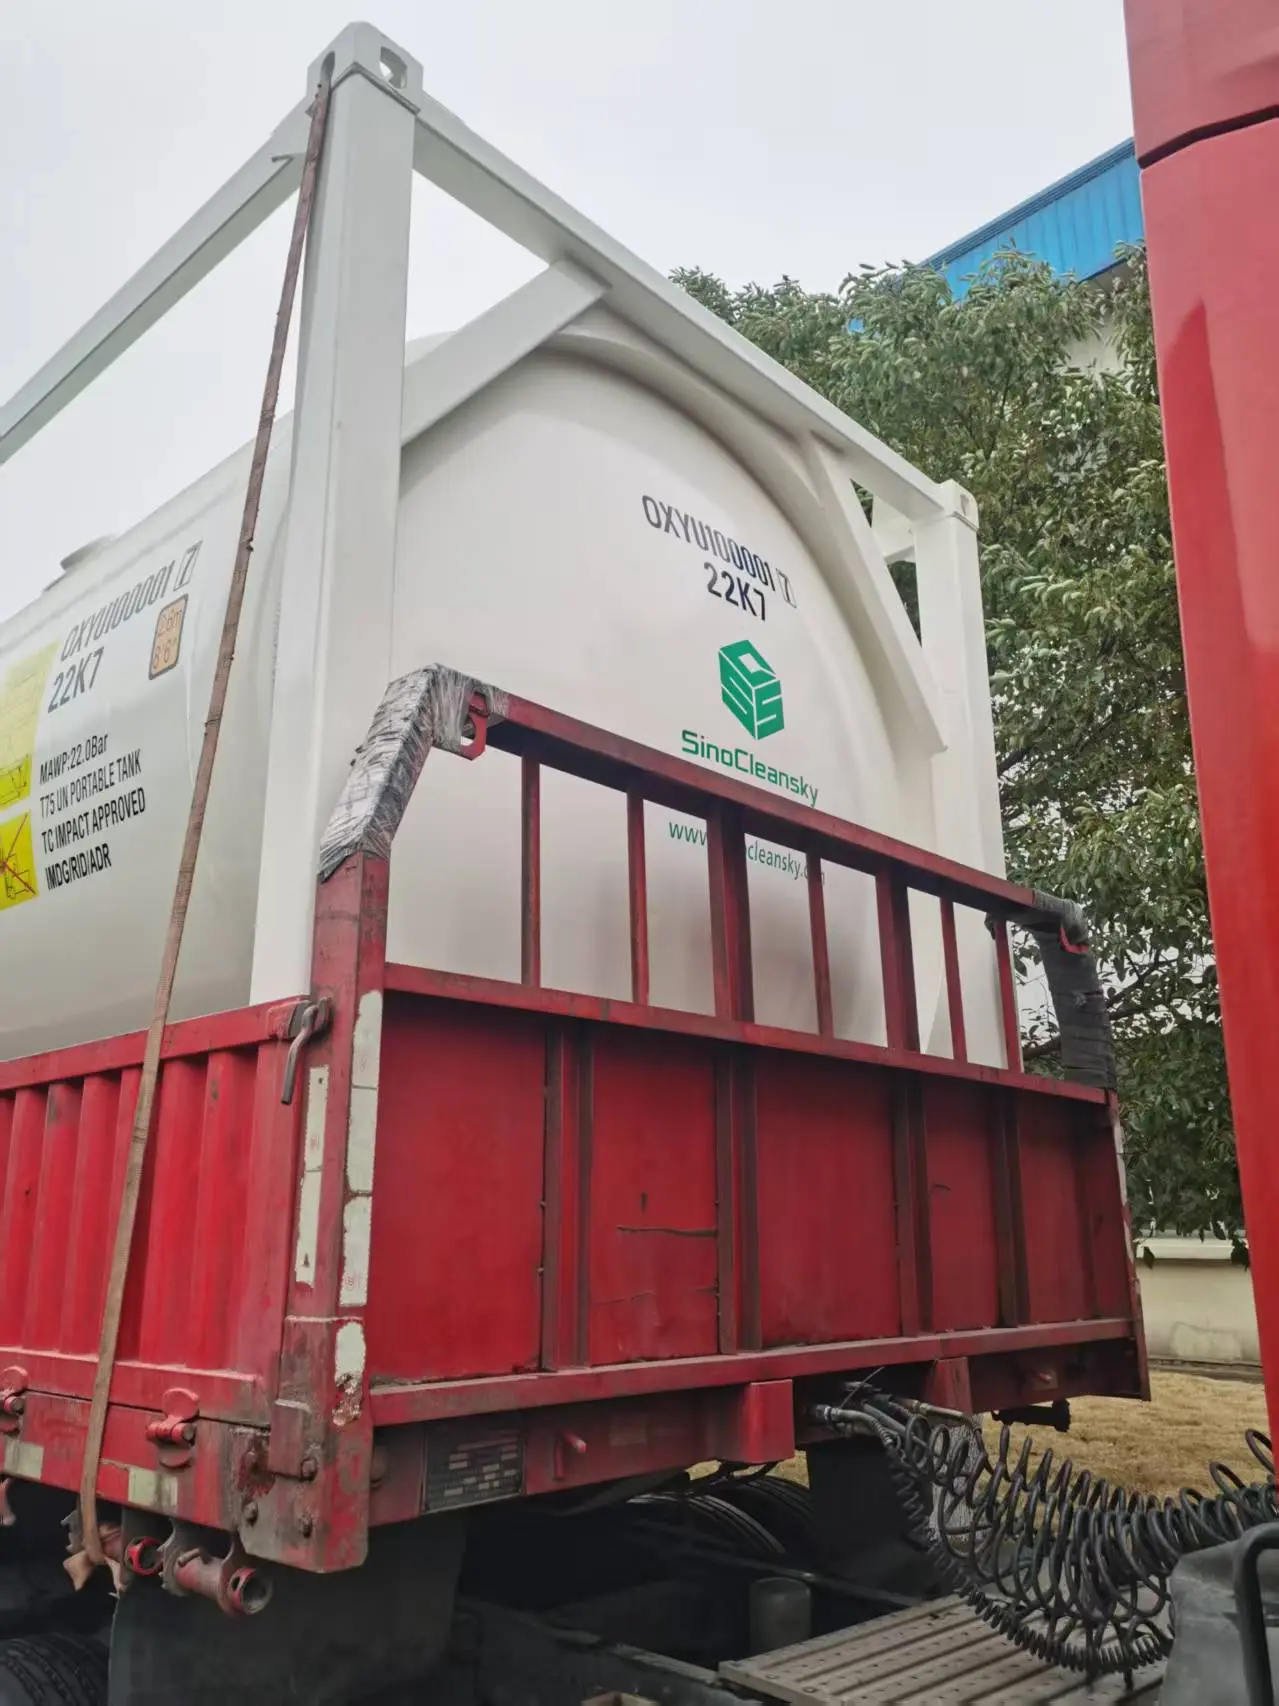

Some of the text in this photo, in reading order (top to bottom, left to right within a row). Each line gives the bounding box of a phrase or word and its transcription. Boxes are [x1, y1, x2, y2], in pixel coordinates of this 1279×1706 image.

[642, 495, 775, 591] OXYU100001
[704, 561, 766, 621] 22K7
[48, 646, 105, 713] 22K7
[40, 748, 142, 818] T75 UN PORTABLE TANK
[681, 729, 818, 808] SinoCleansky
[41, 787, 146, 854] TC IMPACT APPROVED
